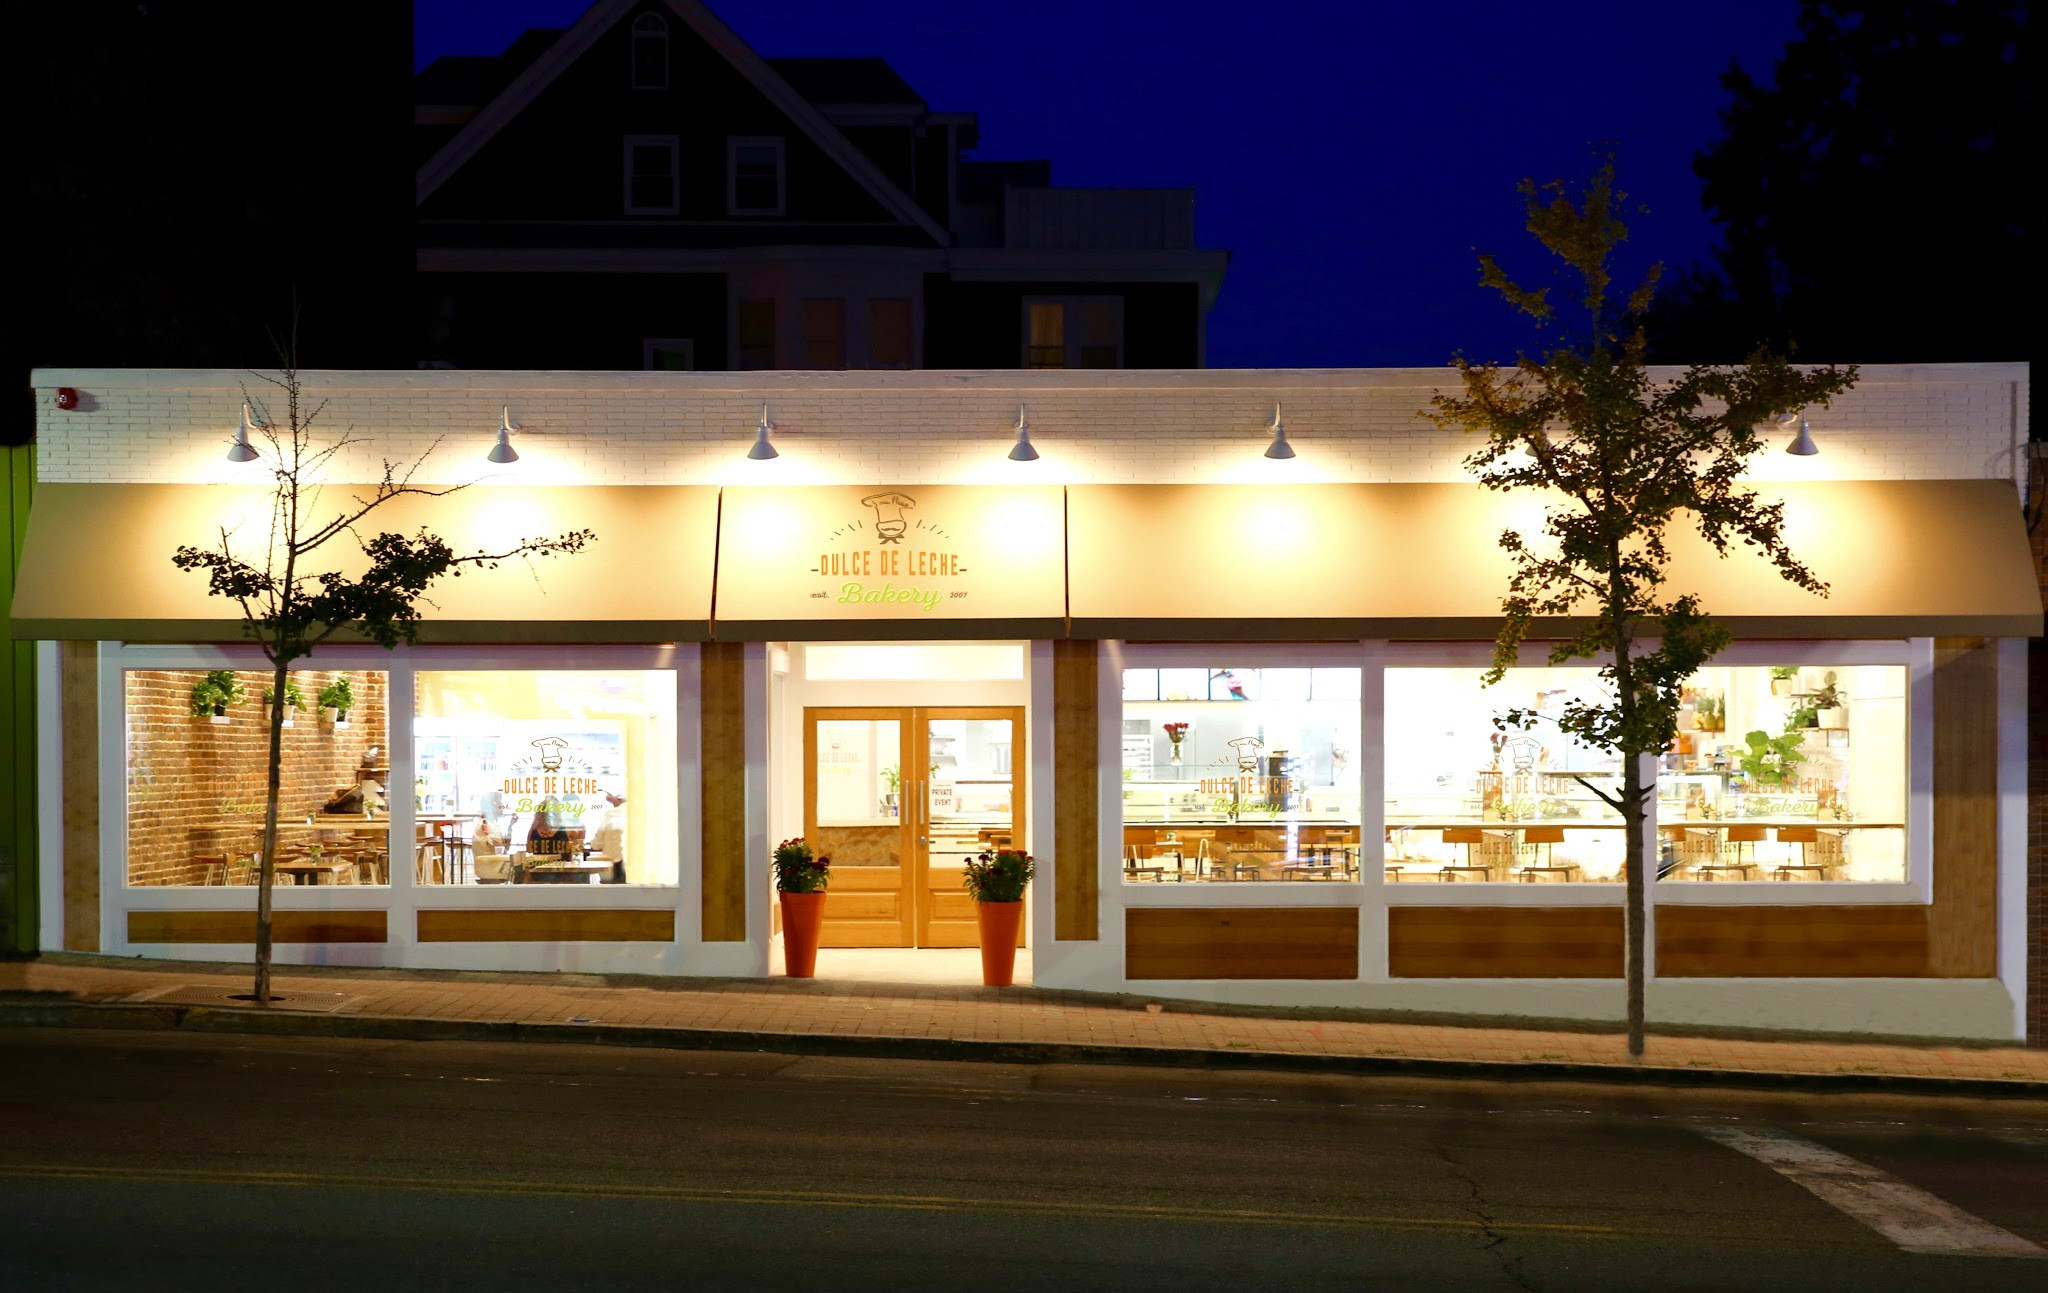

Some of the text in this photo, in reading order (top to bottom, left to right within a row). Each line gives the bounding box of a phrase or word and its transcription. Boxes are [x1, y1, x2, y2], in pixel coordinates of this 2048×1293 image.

[821, 551, 959, 576] DULCE DE LECHE
[837, 582, 943, 612] Bakery
[950, 591, 968, 599] 2007
[504, 777, 597, 794] DULCE DE LECHE
[1201, 777, 1293, 794] DULCE DE LECHE
[1517, 777, 1528, 794] DE
[1536, 777, 1569, 794] LECHE
[1782, 777, 1793, 794] DE
[516, 798, 586, 818] Bakery
[935, 798, 951, 806] EVENT
[1212, 798, 1282, 818] Bakery
[1752, 798, 1820, 818] Bakery
